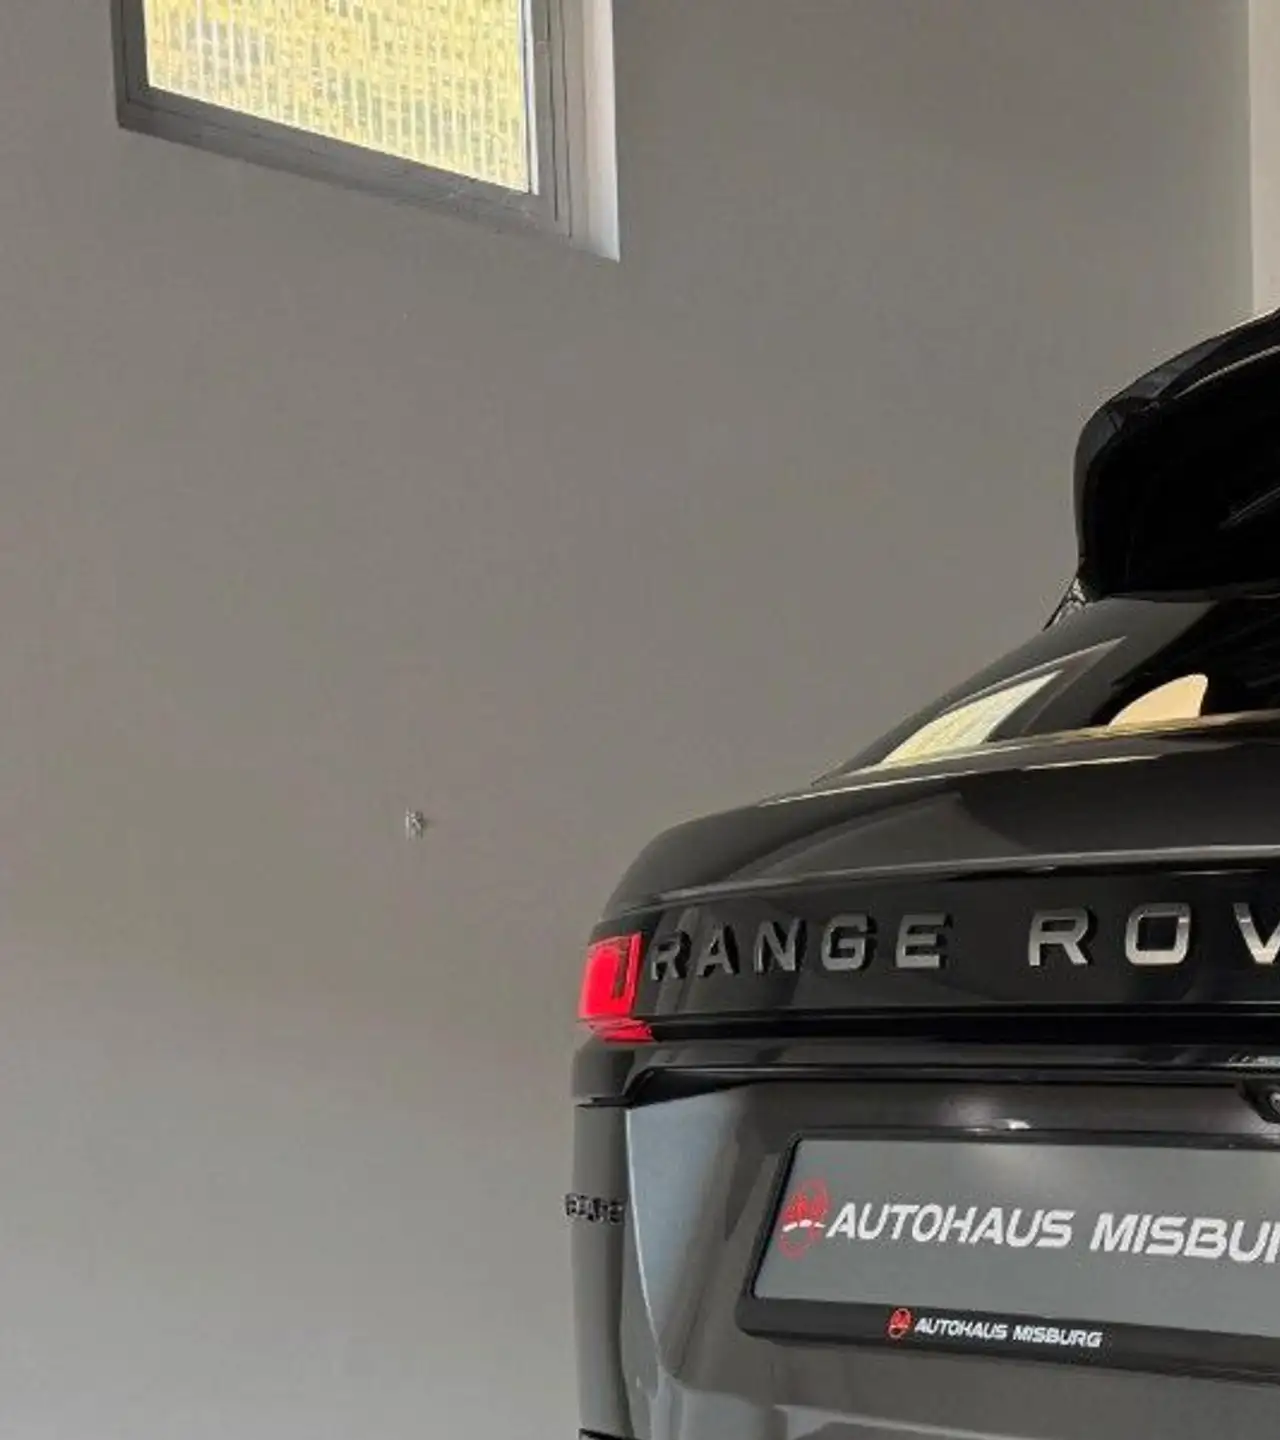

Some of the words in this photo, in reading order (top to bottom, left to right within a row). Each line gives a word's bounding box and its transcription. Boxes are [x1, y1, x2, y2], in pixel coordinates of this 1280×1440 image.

[650, 911, 946, 981] RANGE
[826, 1201, 1077, 1250] AUTOHAUS
[914, 1316, 1009, 1341] AUTOHAUS
[1012, 1324, 1103, 1348] MISBURG
